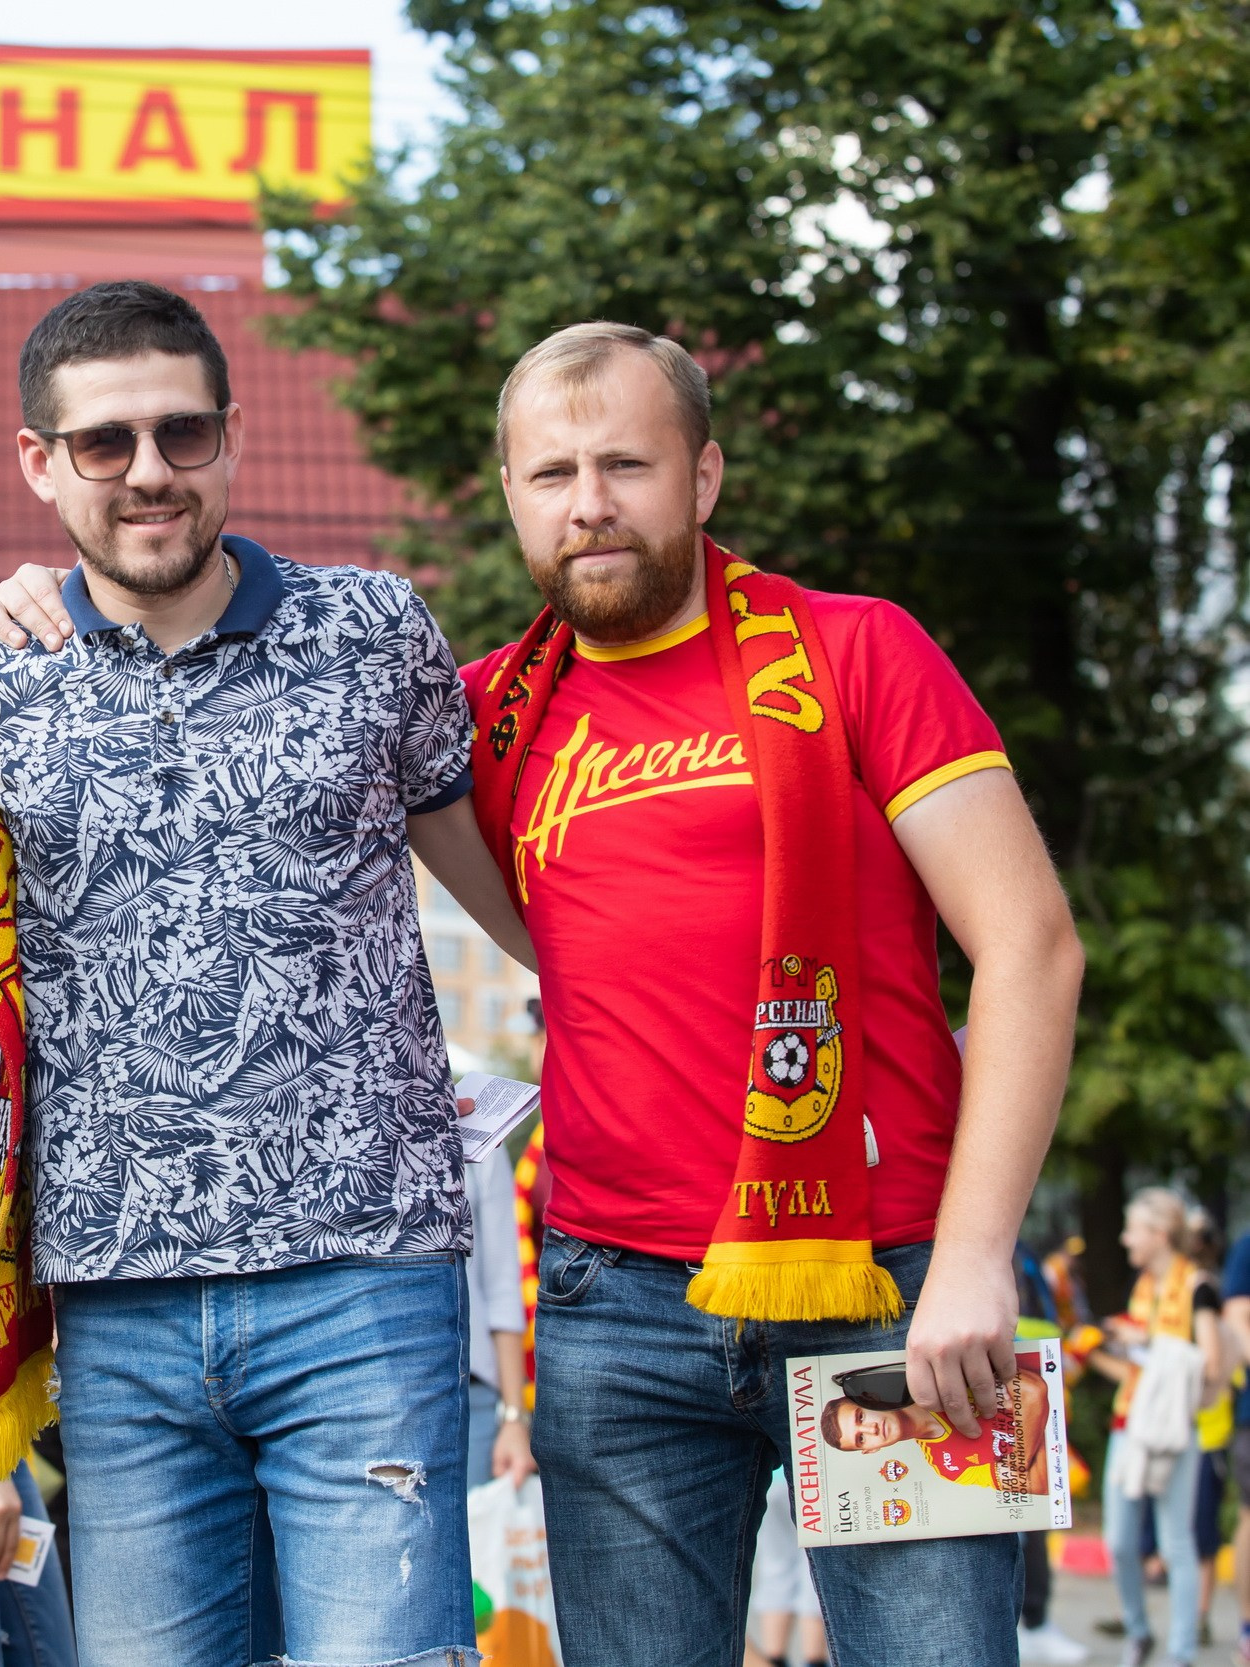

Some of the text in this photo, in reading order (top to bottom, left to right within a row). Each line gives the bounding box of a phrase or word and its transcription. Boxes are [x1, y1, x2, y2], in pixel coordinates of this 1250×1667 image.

[517, 713, 748, 871] Арсена
[754, 1000, 828, 1027] РСЕНАЛ
[733, 1179, 833, 1227] ТУЛА
[1012, 1371, 1023, 1417] РОНАЛД
[1001, 1469, 1011, 1504] КОГДА
[838, 1491, 853, 1533] ЦСКА
[852, 1500, 860, 1532] МОСКВА
